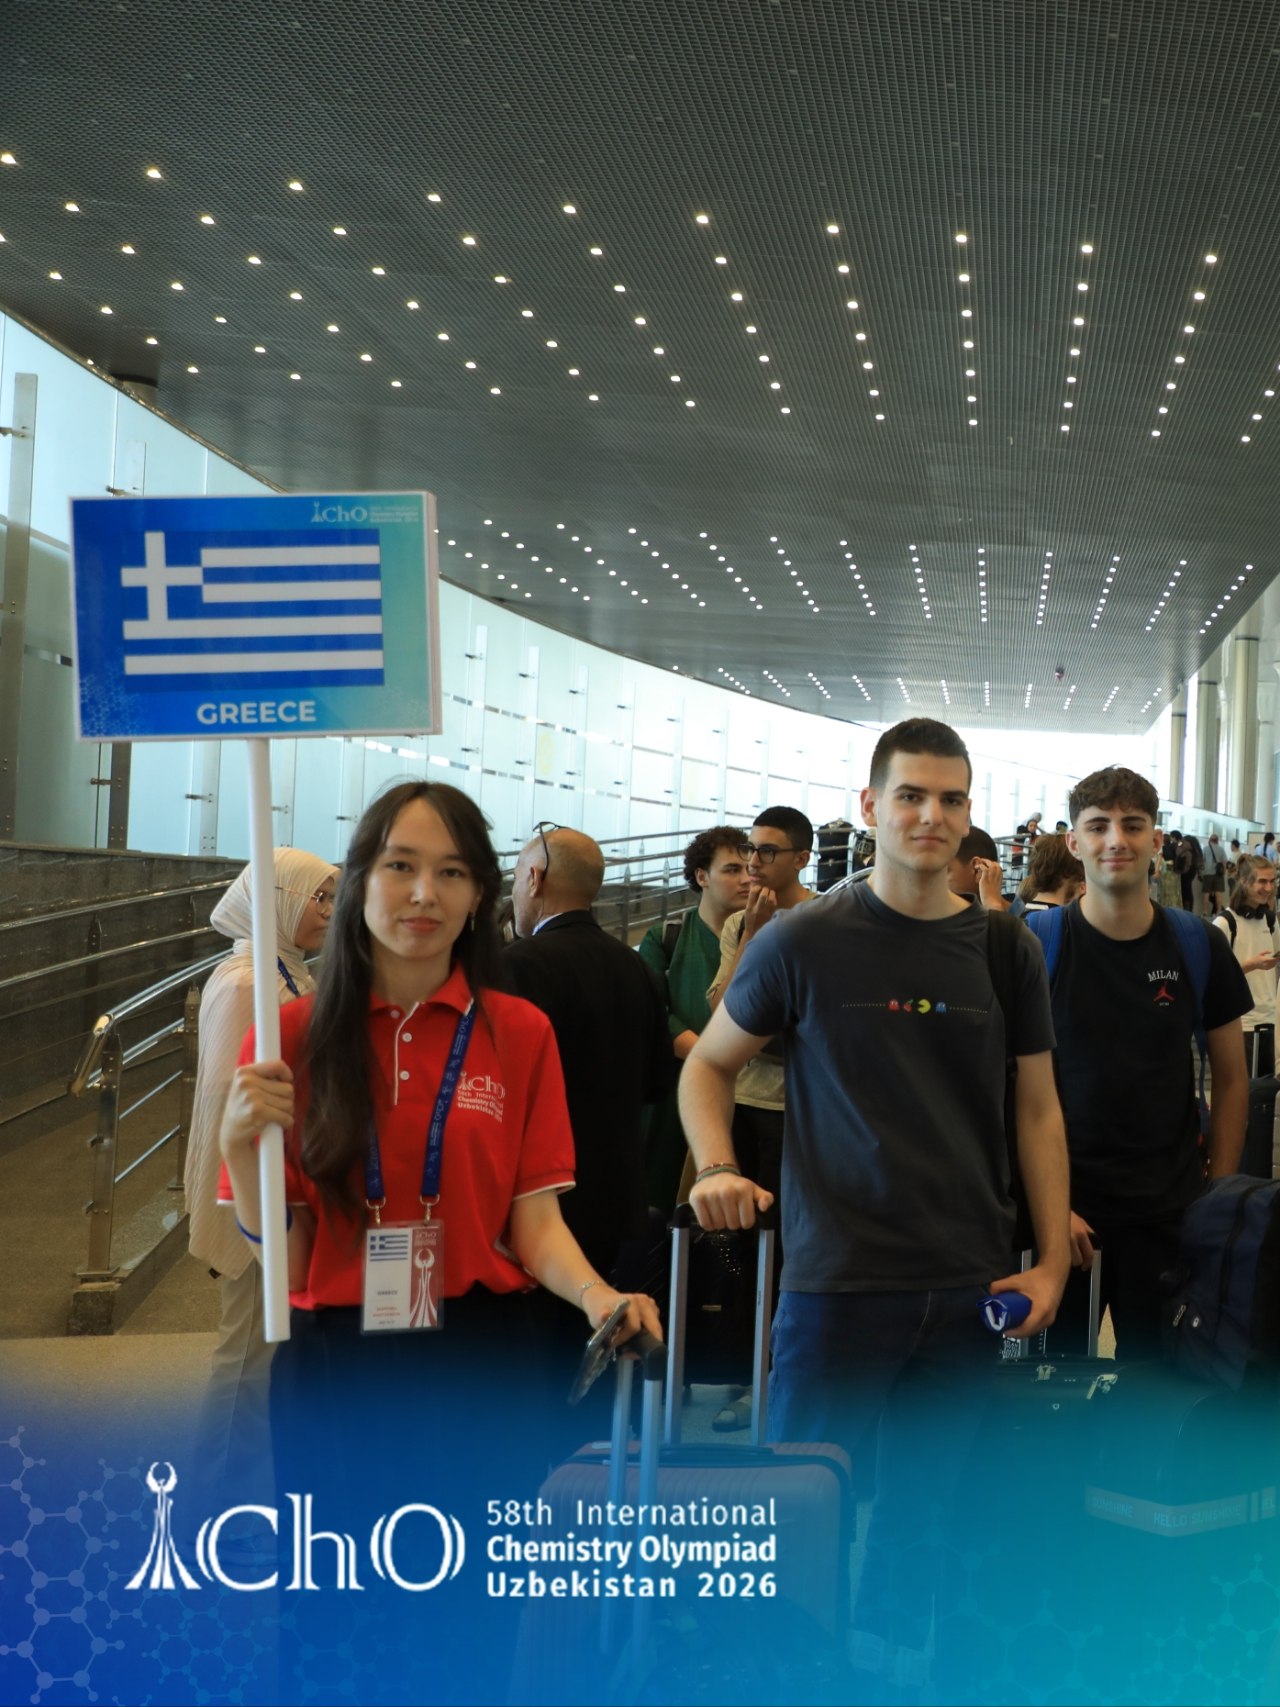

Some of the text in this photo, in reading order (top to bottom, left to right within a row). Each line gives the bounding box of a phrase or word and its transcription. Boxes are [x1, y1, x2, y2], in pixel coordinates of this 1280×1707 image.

[196, 700, 317, 726] GREECE
[1147, 969, 1180, 983] MILAN
[1154, 1512, 1187, 1528] HELLO
